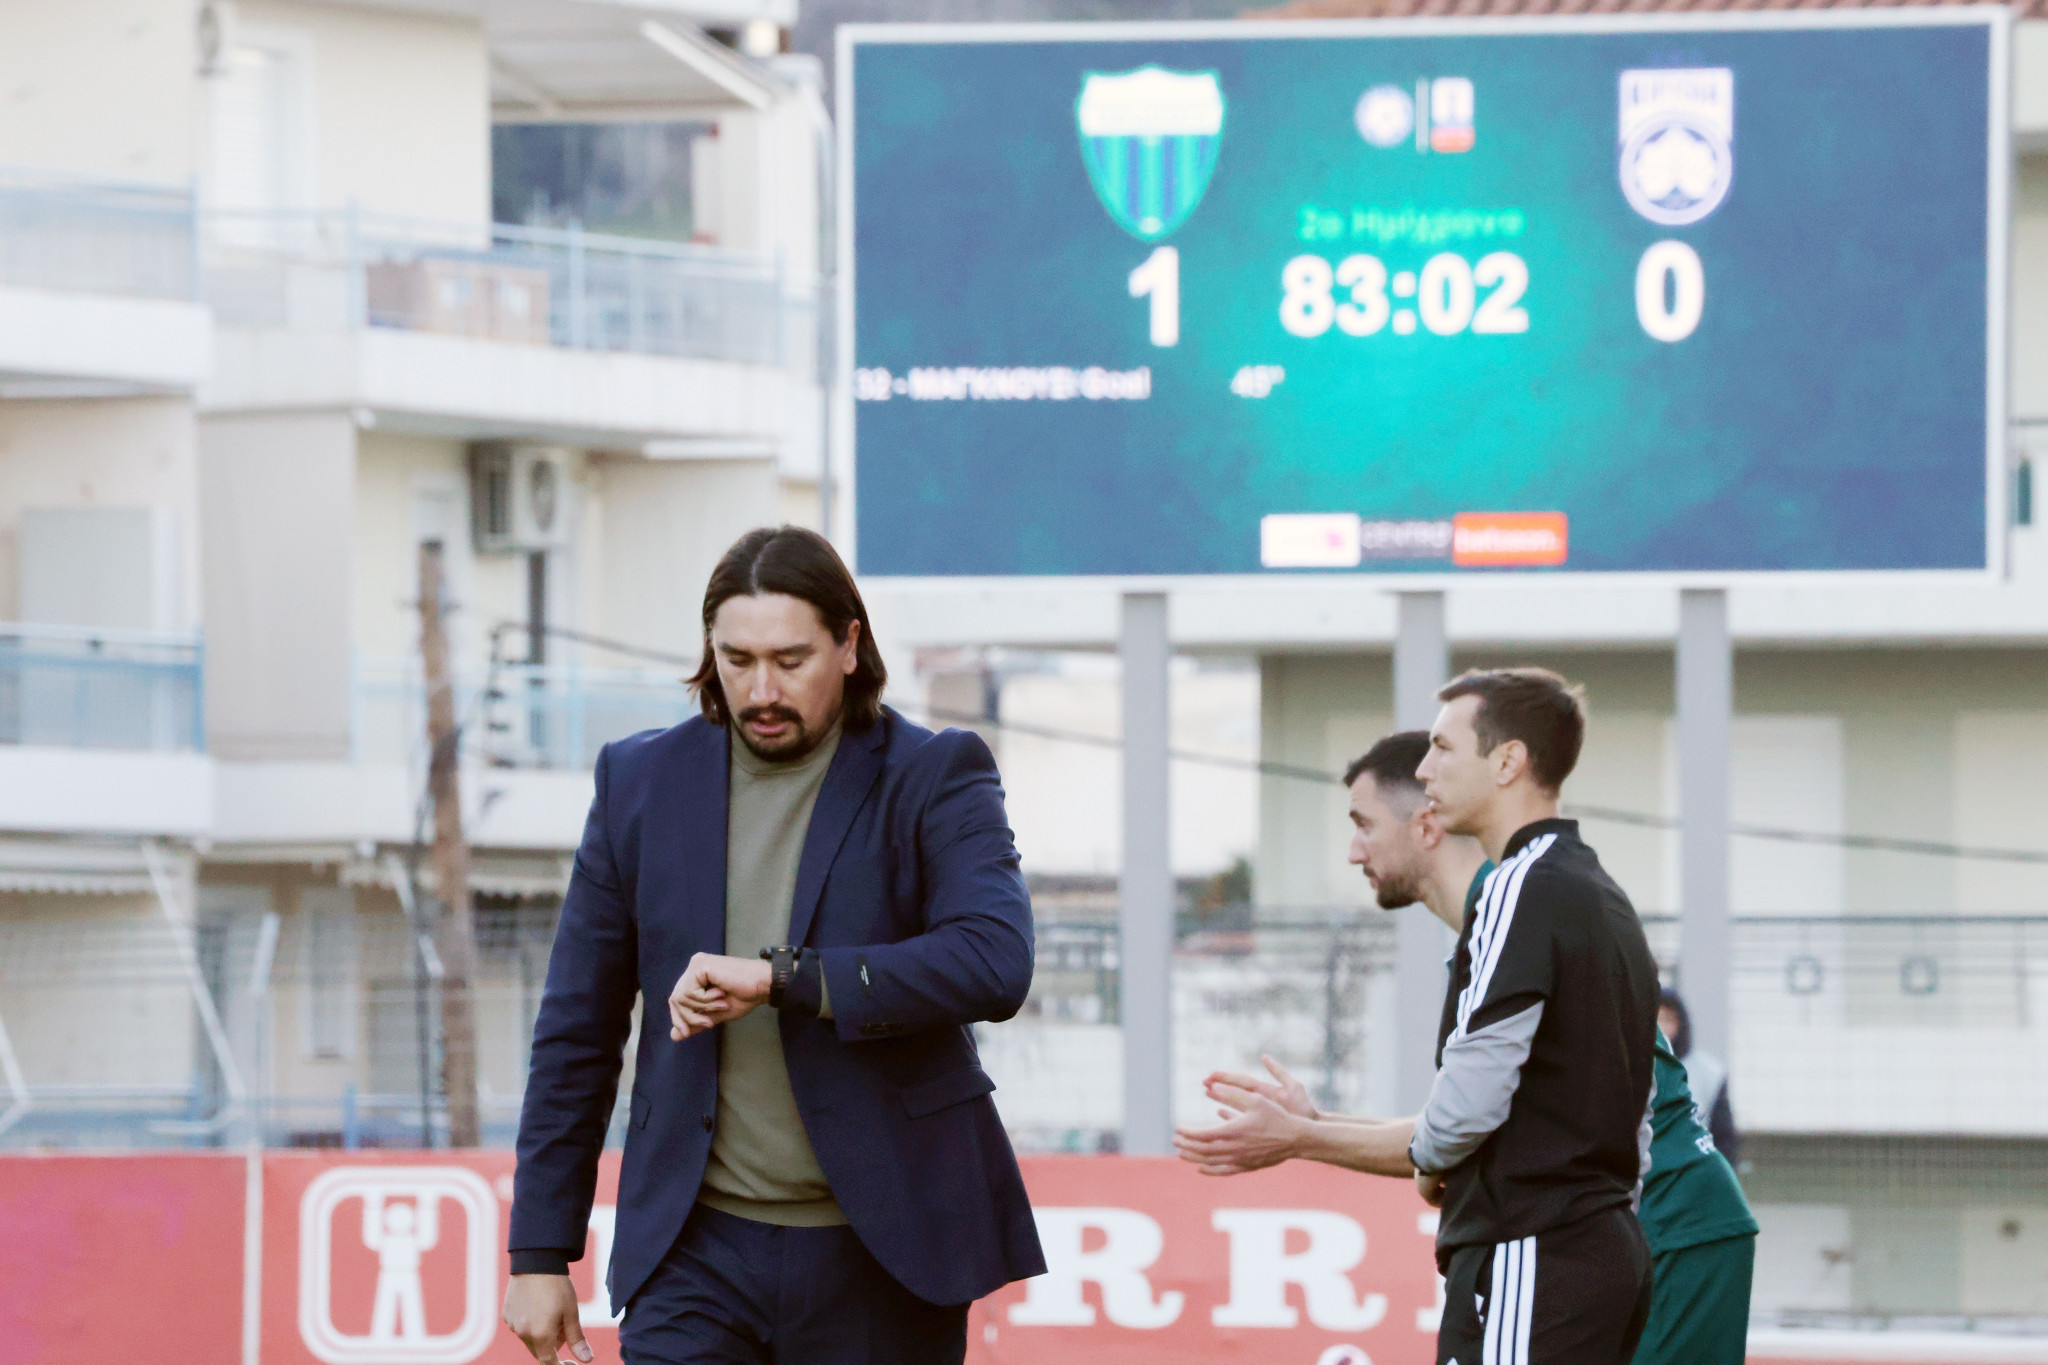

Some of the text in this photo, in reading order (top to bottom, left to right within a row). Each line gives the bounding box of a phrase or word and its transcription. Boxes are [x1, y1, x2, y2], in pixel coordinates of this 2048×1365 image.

[1128, 246, 1179, 347] 1
[1280, 253, 1529, 337] 83:02
[1635, 240, 1704, 343] 0
